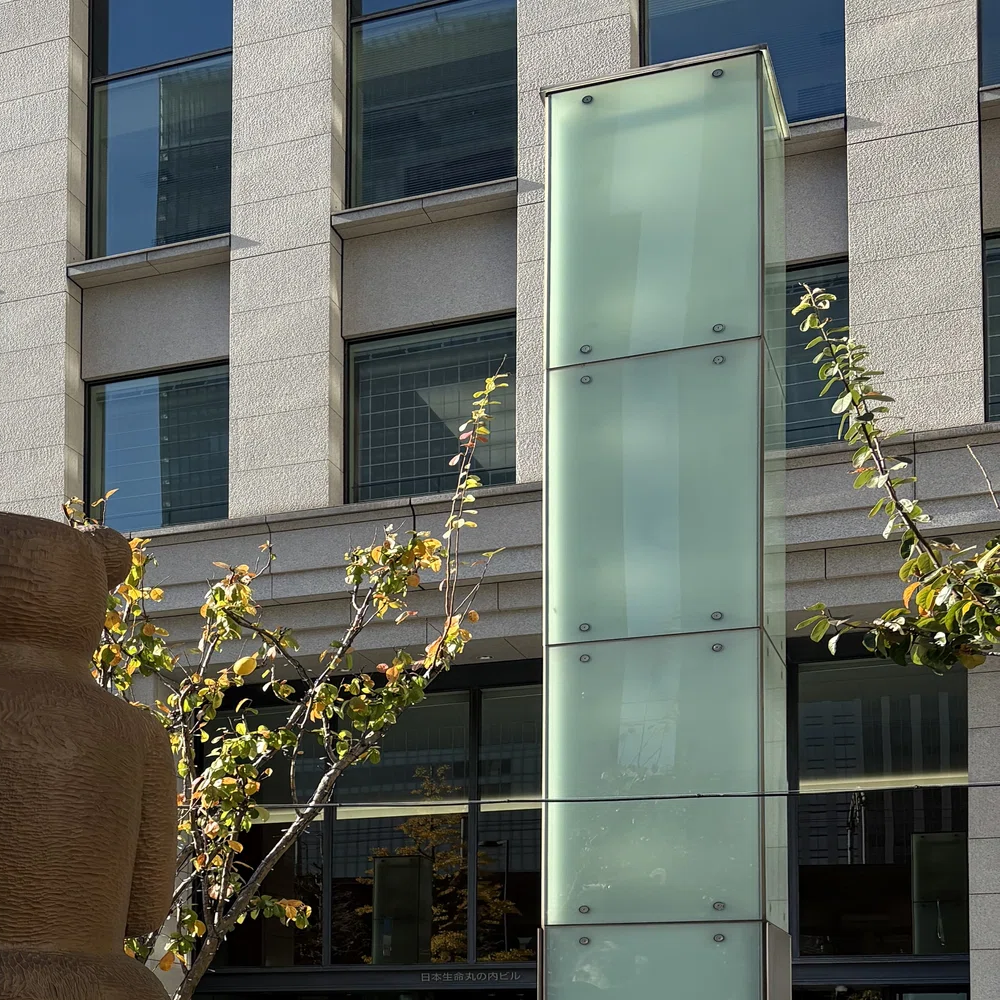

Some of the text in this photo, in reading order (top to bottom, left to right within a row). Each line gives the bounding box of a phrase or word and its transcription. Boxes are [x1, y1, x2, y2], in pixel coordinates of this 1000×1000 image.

[421, 971, 521, 982] 日本生命丸の内ビル
